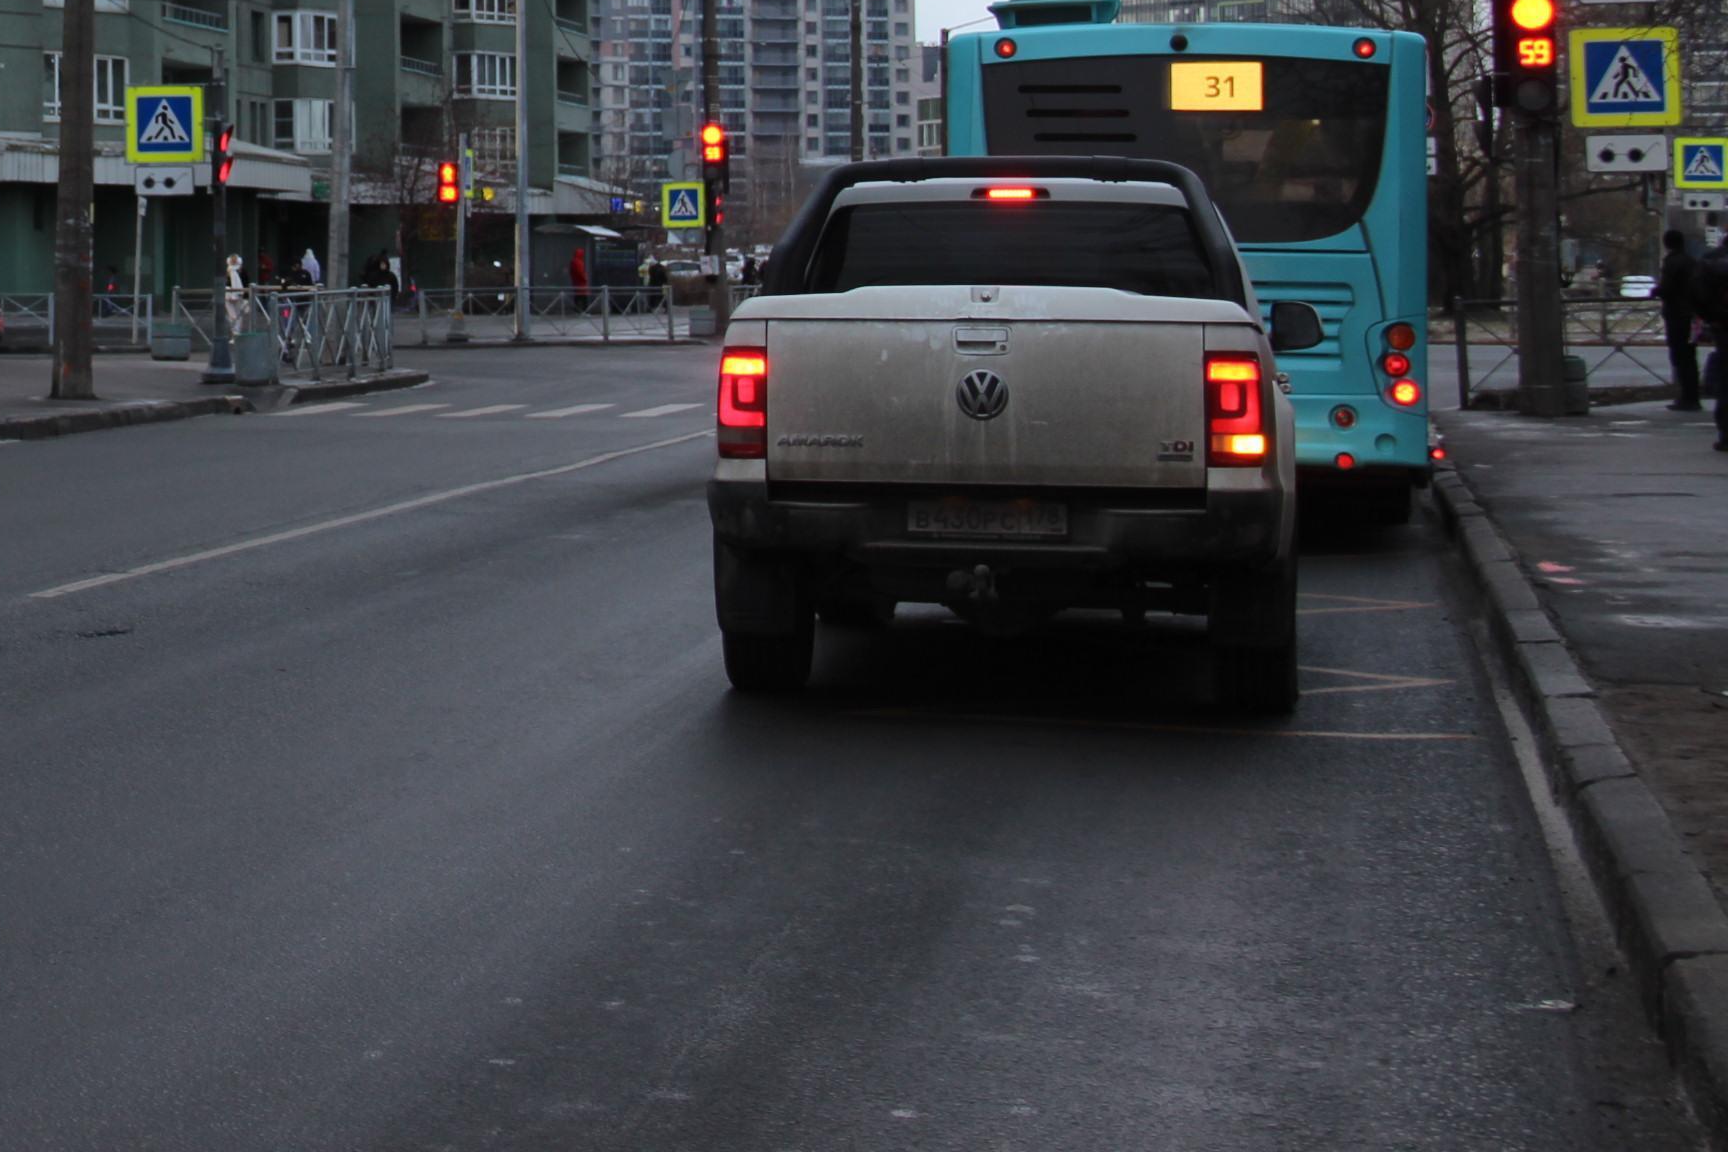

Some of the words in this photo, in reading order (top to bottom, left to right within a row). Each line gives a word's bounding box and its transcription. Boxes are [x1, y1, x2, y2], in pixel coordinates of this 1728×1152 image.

[1519, 39, 1550, 65] 59
[1204, 76, 1234, 98] 31
[776, 434, 865, 448] AMAROK
[1160, 441, 1194, 453] TDI
